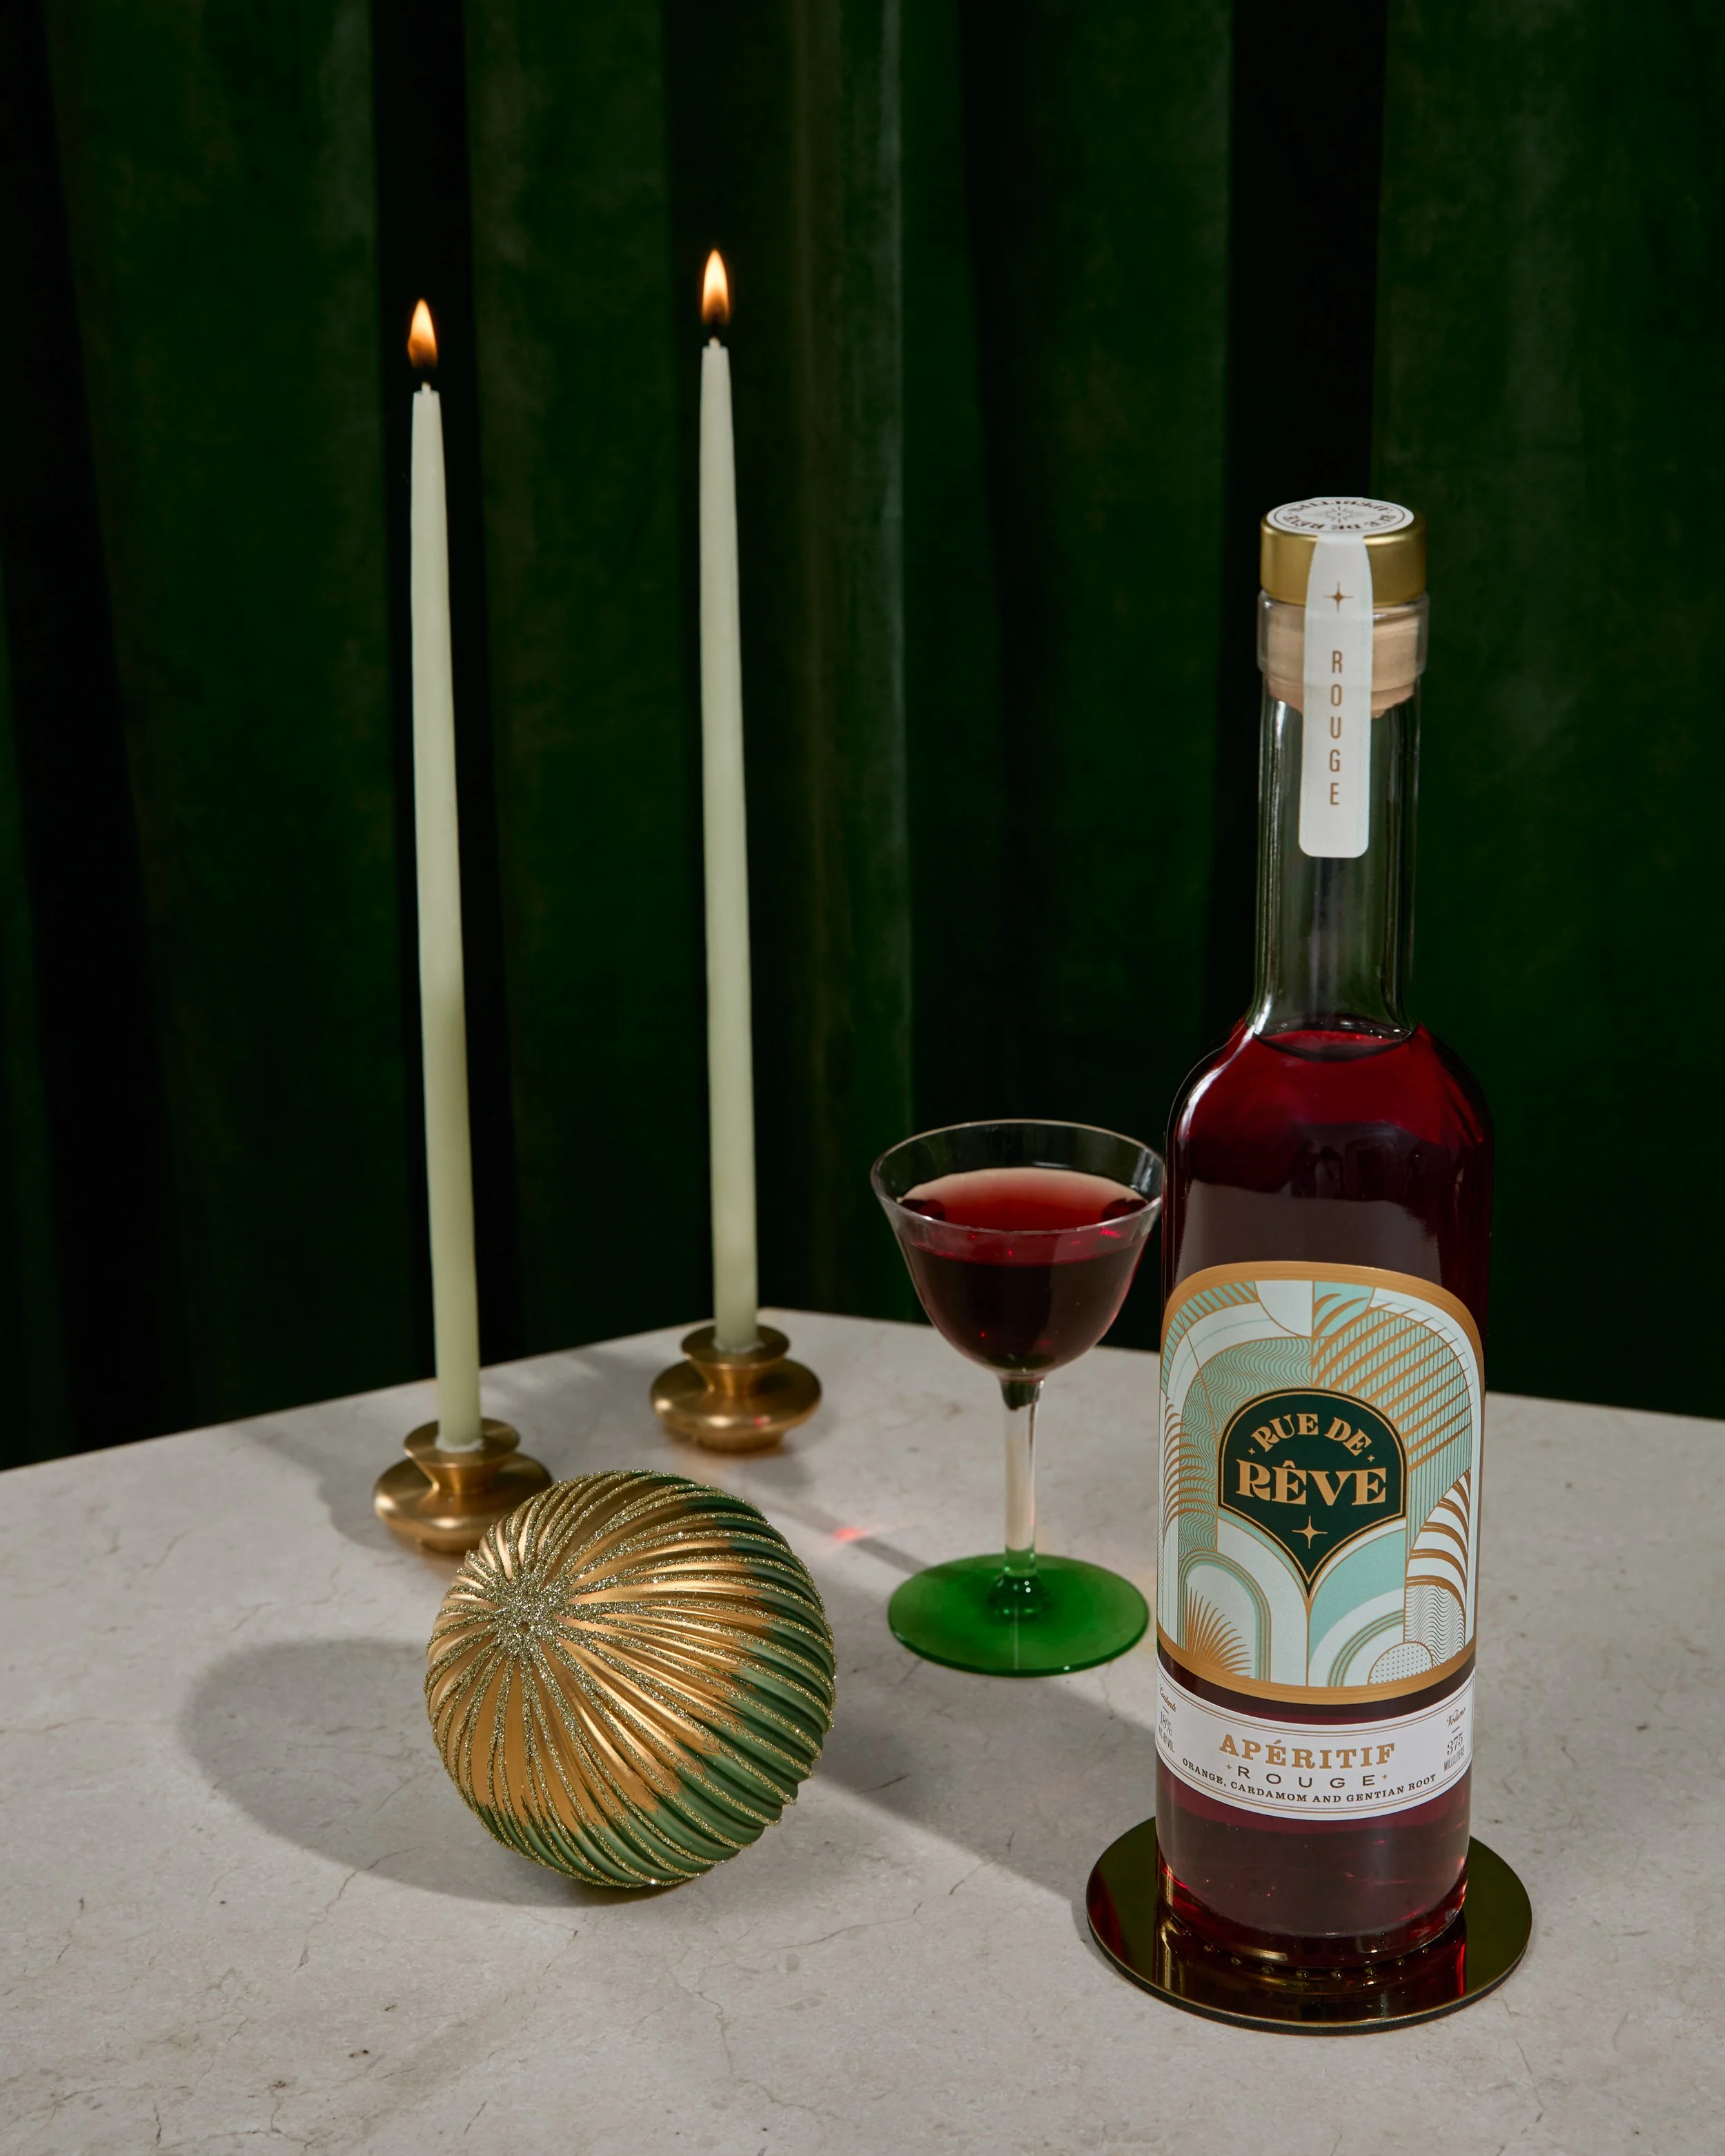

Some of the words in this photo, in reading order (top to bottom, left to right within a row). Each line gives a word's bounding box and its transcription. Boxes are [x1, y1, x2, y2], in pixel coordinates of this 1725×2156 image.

[1329, 650, 1343, 806] ROUGE
[1251, 1413, 1319, 1452] RUE
[1324, 1416, 1372, 1456] DE
[1236, 1458, 1387, 1506] RÊVE
[1160, 1711, 1173, 1736] 18%
[1219, 1734, 1395, 1770] APÉRITIF
[1447, 1732, 1463, 1755] 375
[1182, 1758, 1227, 1787] ORANGE,
[1230, 1781, 1307, 1802] CARDAMOM
[1346, 1786, 1405, 1802] GENTIAN
[1408, 1774, 1436, 1791] ROOT
[1237, 1766, 1375, 1788] ROUGE
